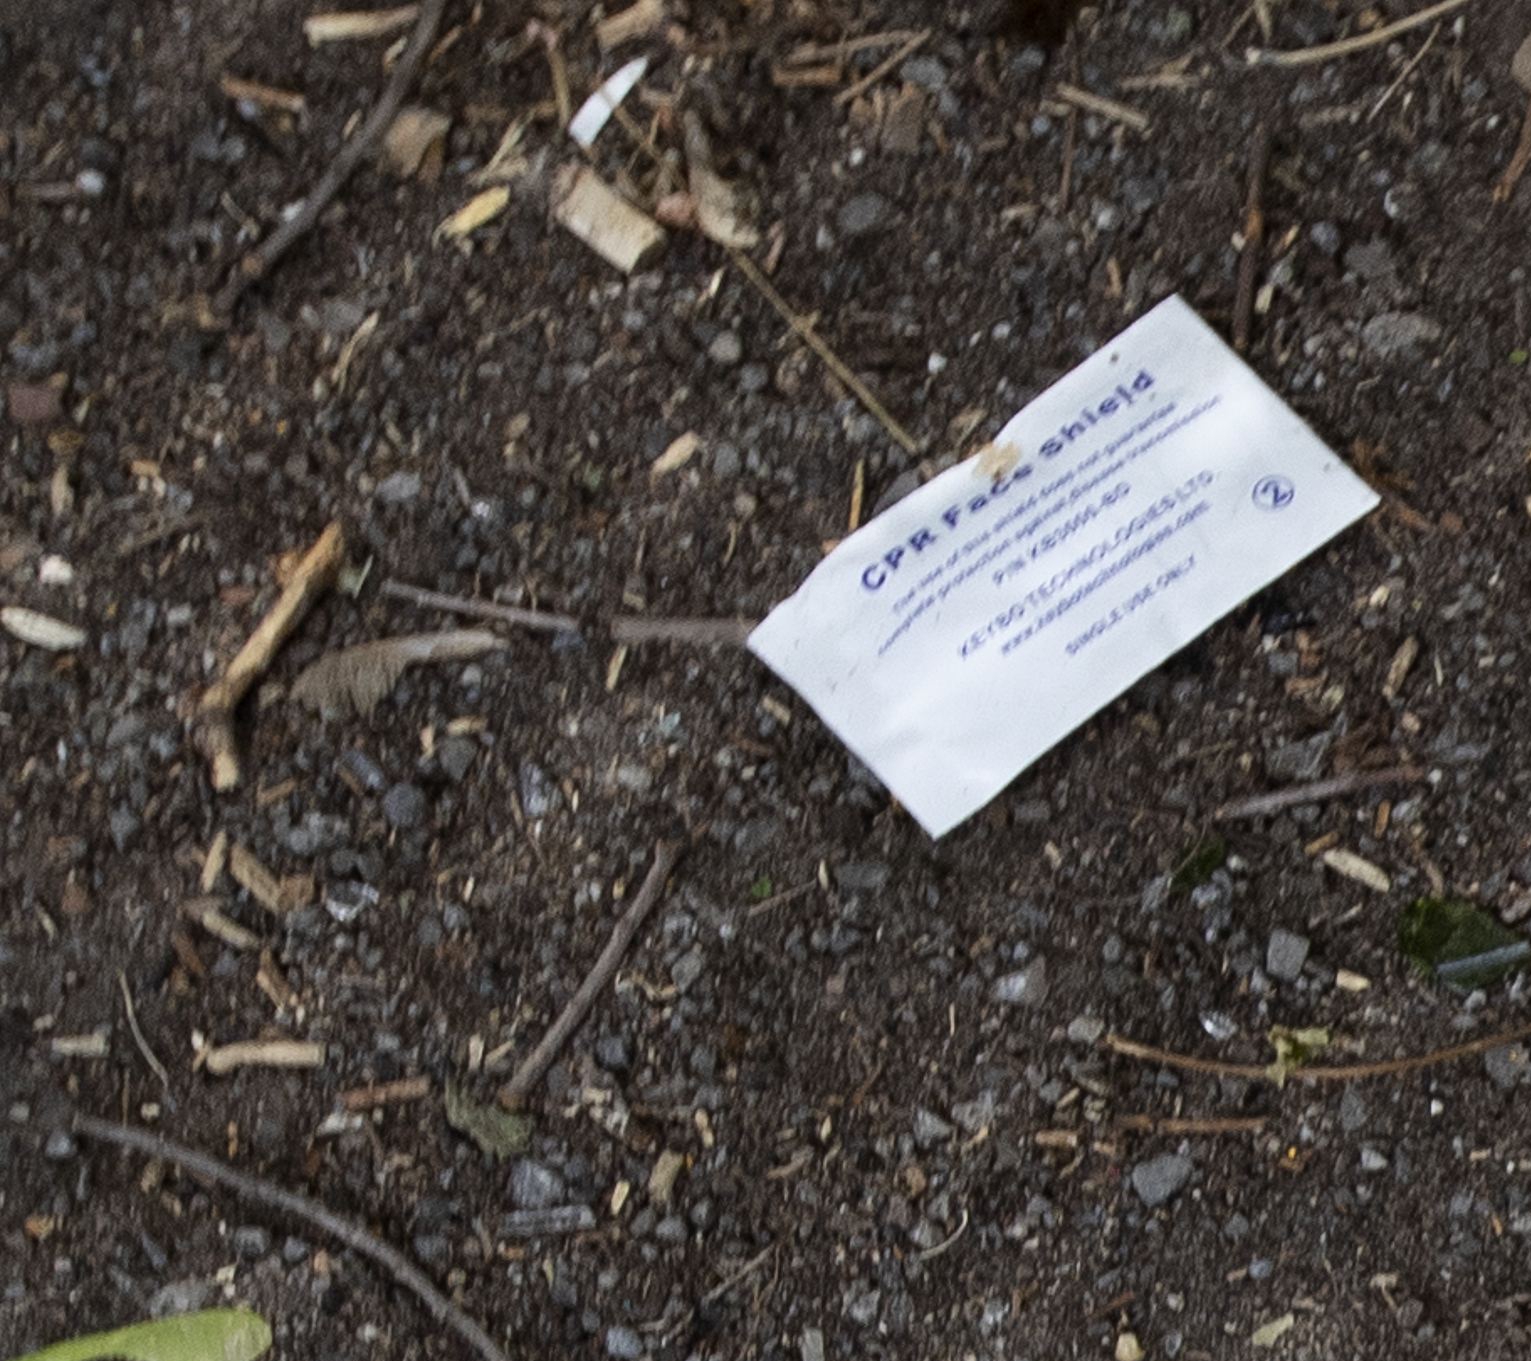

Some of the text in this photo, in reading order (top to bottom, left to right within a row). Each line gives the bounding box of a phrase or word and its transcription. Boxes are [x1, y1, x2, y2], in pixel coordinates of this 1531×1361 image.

[861, 528, 937, 591] CPR
[942, 465, 1033, 529] Face
[1039, 370, 1154, 459] Shield
